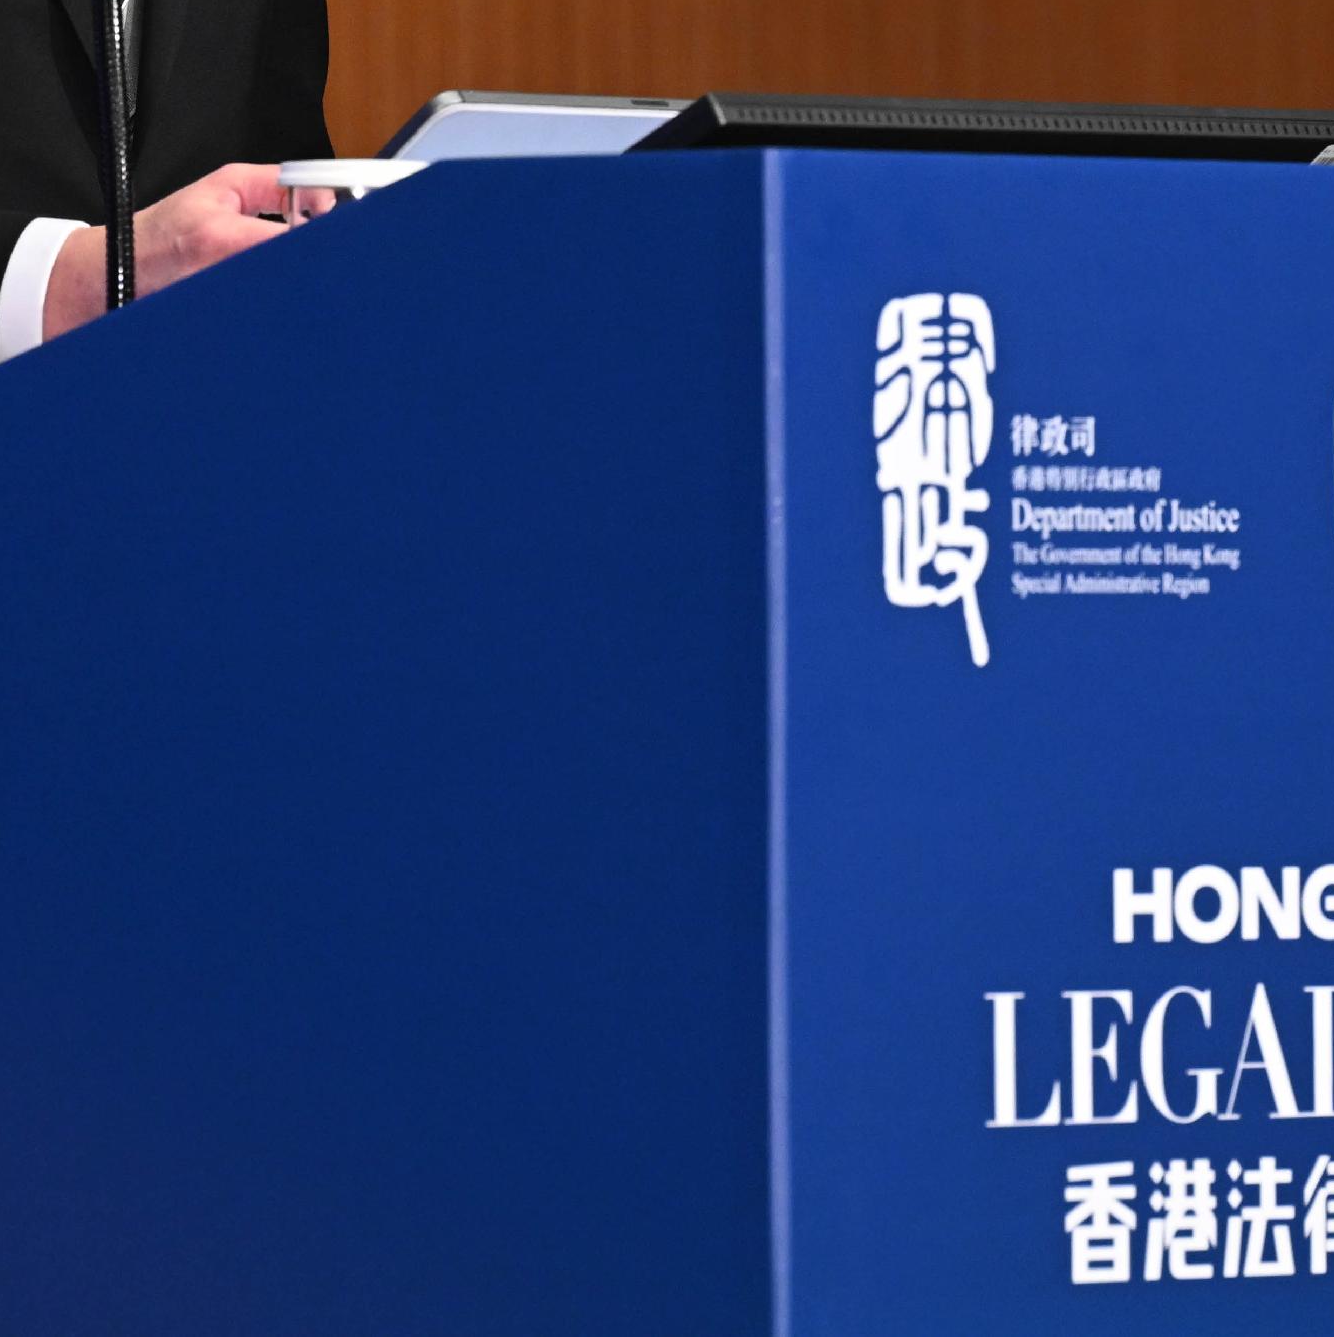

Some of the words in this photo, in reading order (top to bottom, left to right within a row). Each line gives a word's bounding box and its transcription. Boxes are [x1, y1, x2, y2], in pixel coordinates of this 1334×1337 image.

[1011, 414, 1095, 457] 律政司
[1012, 497, 1136, 540] Department
[1140, 498, 1167, 532] of
[1168, 499, 1240, 532] Justice
[1013, 542, 1039, 564] The
[1039, 544, 1122, 565] Government
[1124, 544, 1141, 564] of
[1141, 544, 1163, 565] the
[1164, 544, 1201, 569] Hong
[1203, 544, 1240, 570] Kong
[1012, 572, 1061, 598] Special
[1064, 573, 1160, 593] Administrative
[1162, 572, 1210, 599] Region
